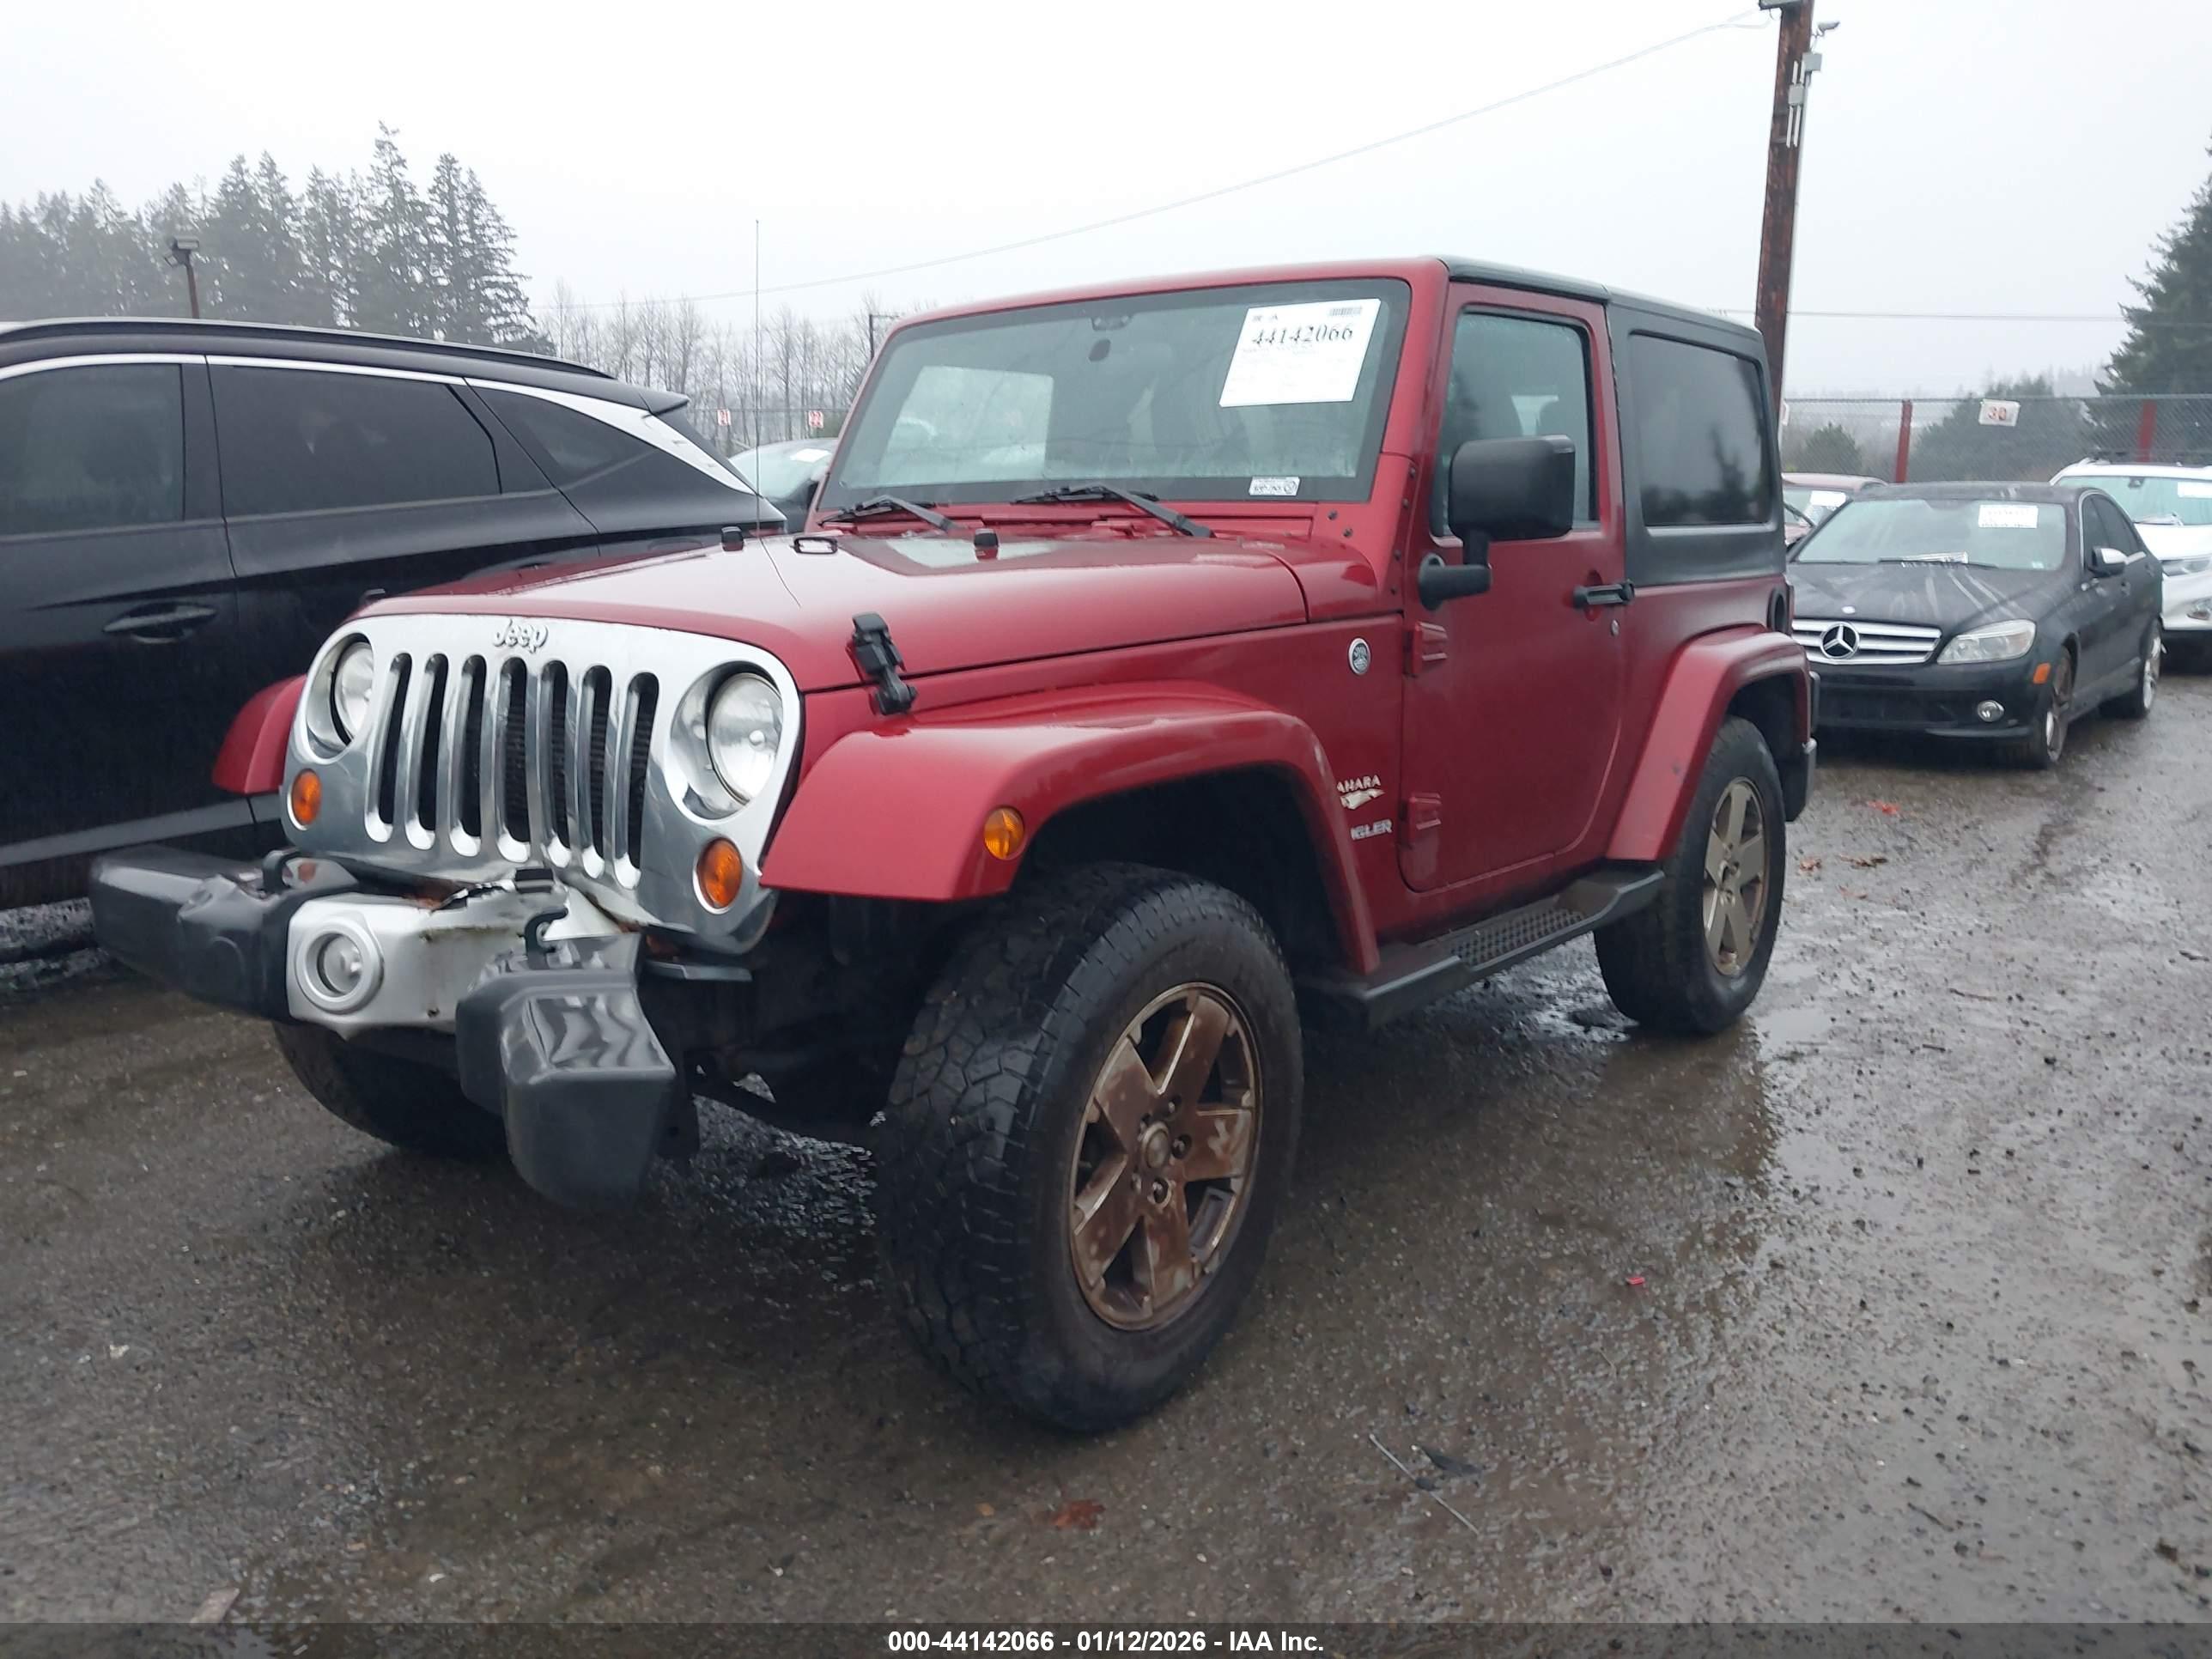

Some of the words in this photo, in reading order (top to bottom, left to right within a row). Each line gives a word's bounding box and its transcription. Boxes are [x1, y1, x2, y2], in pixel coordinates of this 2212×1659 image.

[1252, 323, 1353, 345] 44142066
[492, 617, 549, 654] Jeep
[1336, 775, 1381, 793] AHARA
